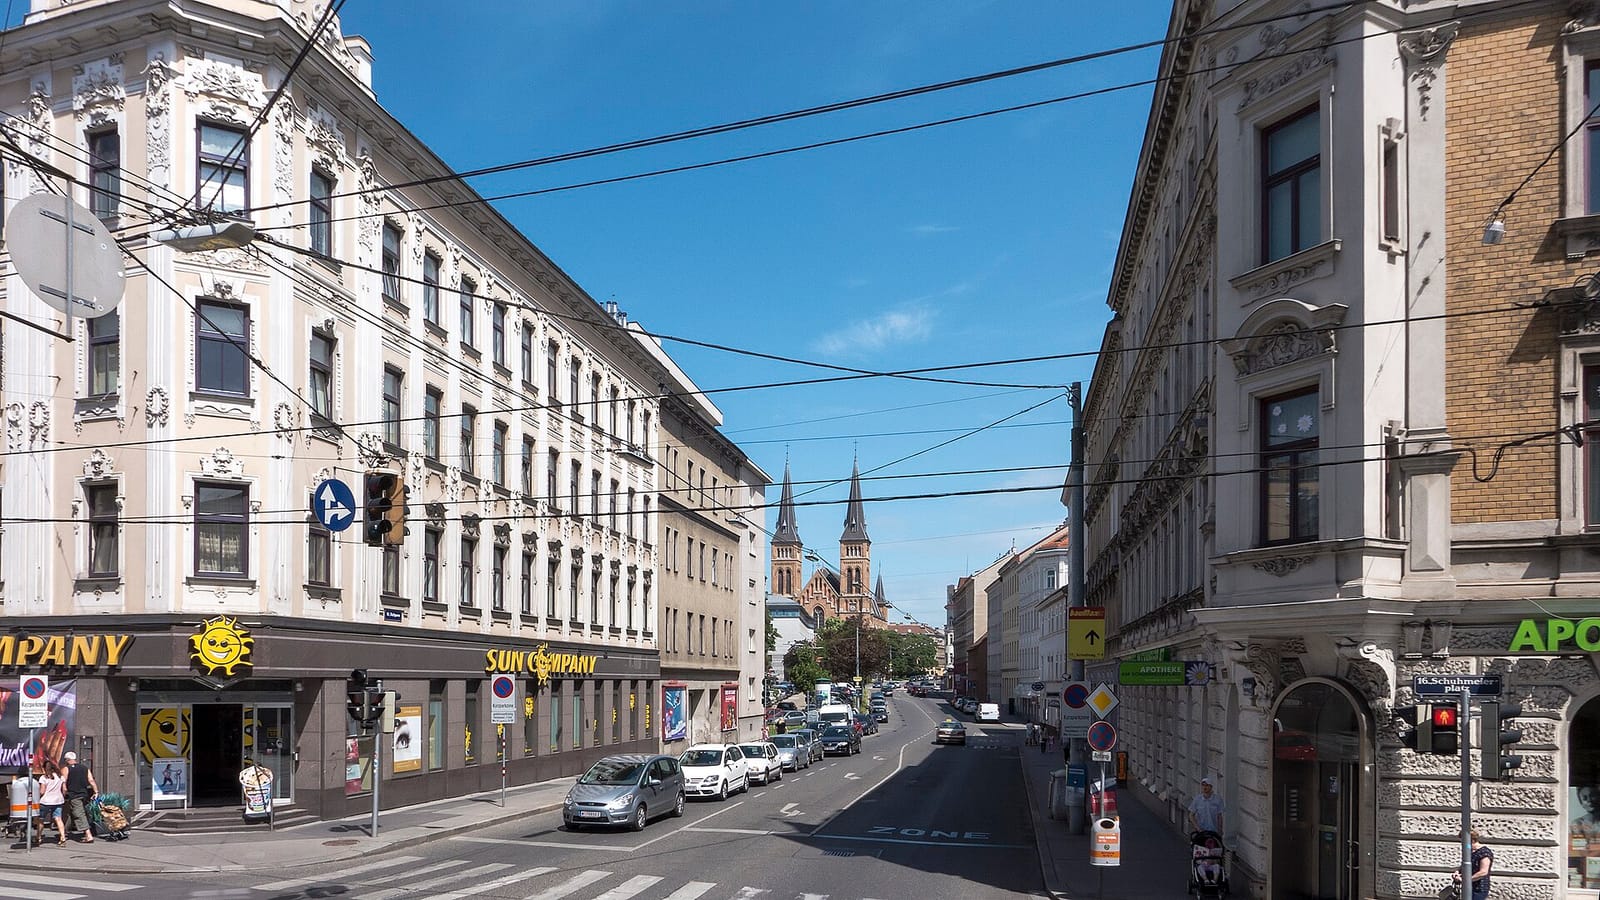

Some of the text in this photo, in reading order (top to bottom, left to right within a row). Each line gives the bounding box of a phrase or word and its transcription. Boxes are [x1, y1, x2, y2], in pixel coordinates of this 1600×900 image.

[1508, 617, 1600, 652] APO
[486, 649, 524, 672] SUN
[867, 826, 991, 839] ZONE
